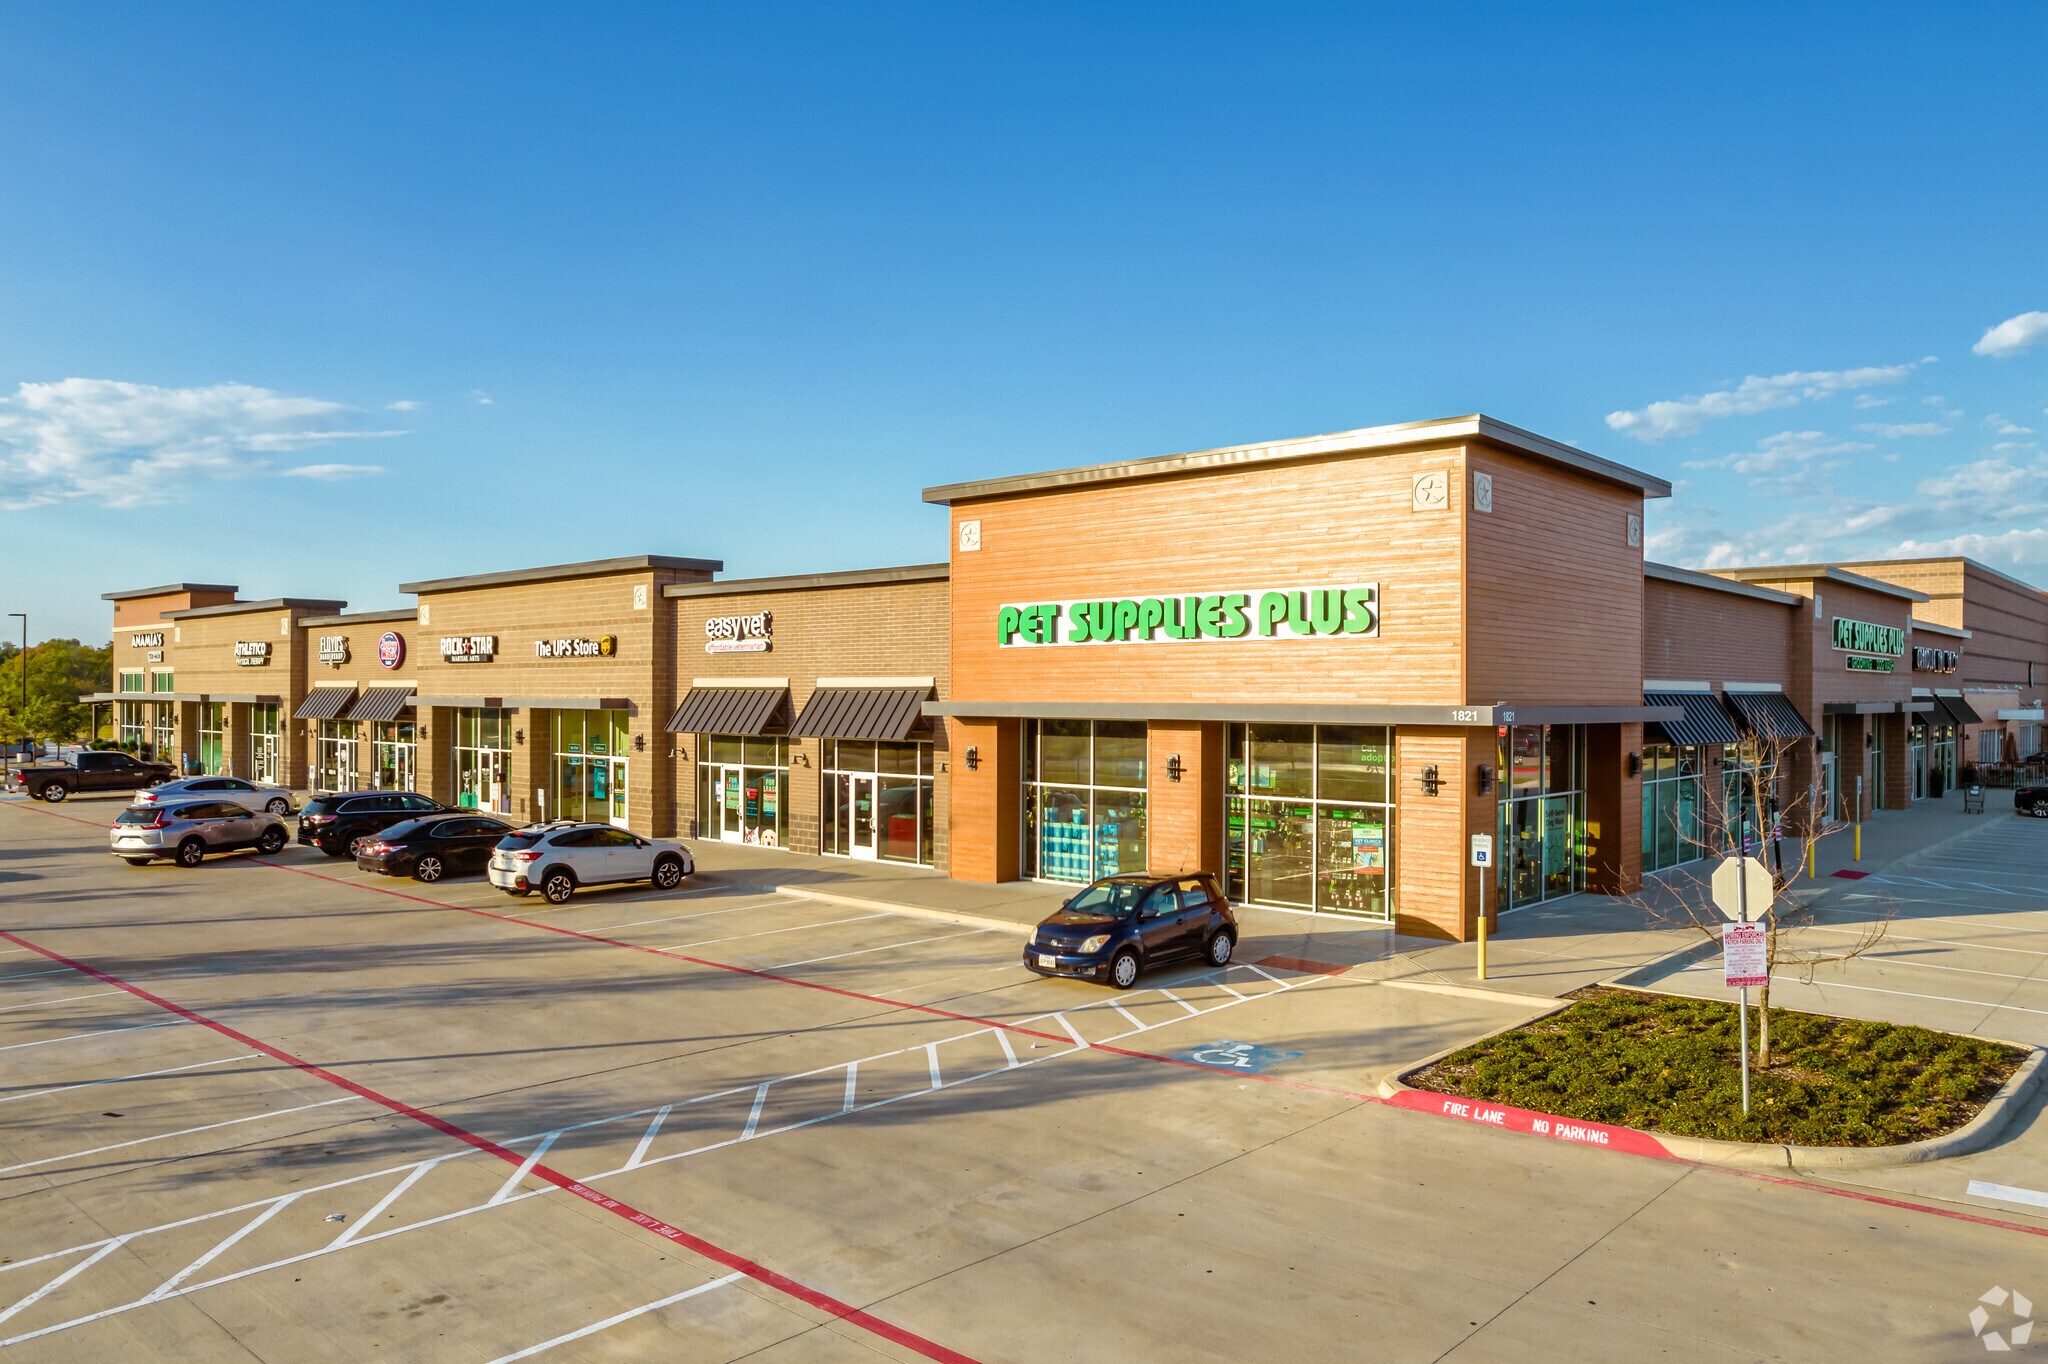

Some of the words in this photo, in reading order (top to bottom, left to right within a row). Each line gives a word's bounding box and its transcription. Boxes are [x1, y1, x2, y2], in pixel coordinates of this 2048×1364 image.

[998, 604, 1062, 645] PET
[1068, 593, 1250, 642] SUPPLIES
[1258, 588, 1374, 636] PLUS
[440, 637, 463, 655] ROCK
[470, 636, 493, 655] STAR
[1838, 619, 1854, 649] PET
[1854, 621, 1888, 653] SUPPLIES
[1888, 628, 1905, 656] PLUS
[234, 641, 267, 656] ATHLETICO
[534, 640, 551, 657] The
[552, 639, 571, 656] UPS
[573, 638, 599, 655] Store
[1452, 710, 1478, 722] 1821
[1503, 711, 1515, 722] 1821
[1443, 1101, 1470, 1117] FIRE
[1474, 1107, 1506, 1125] LANE
[1532, 1118, 1550, 1134] NO
[1555, 1123, 1609, 1145] PARKING
[629, 1213, 660, 1228] LANE
[655, 1225, 683, 1239] FIRE
